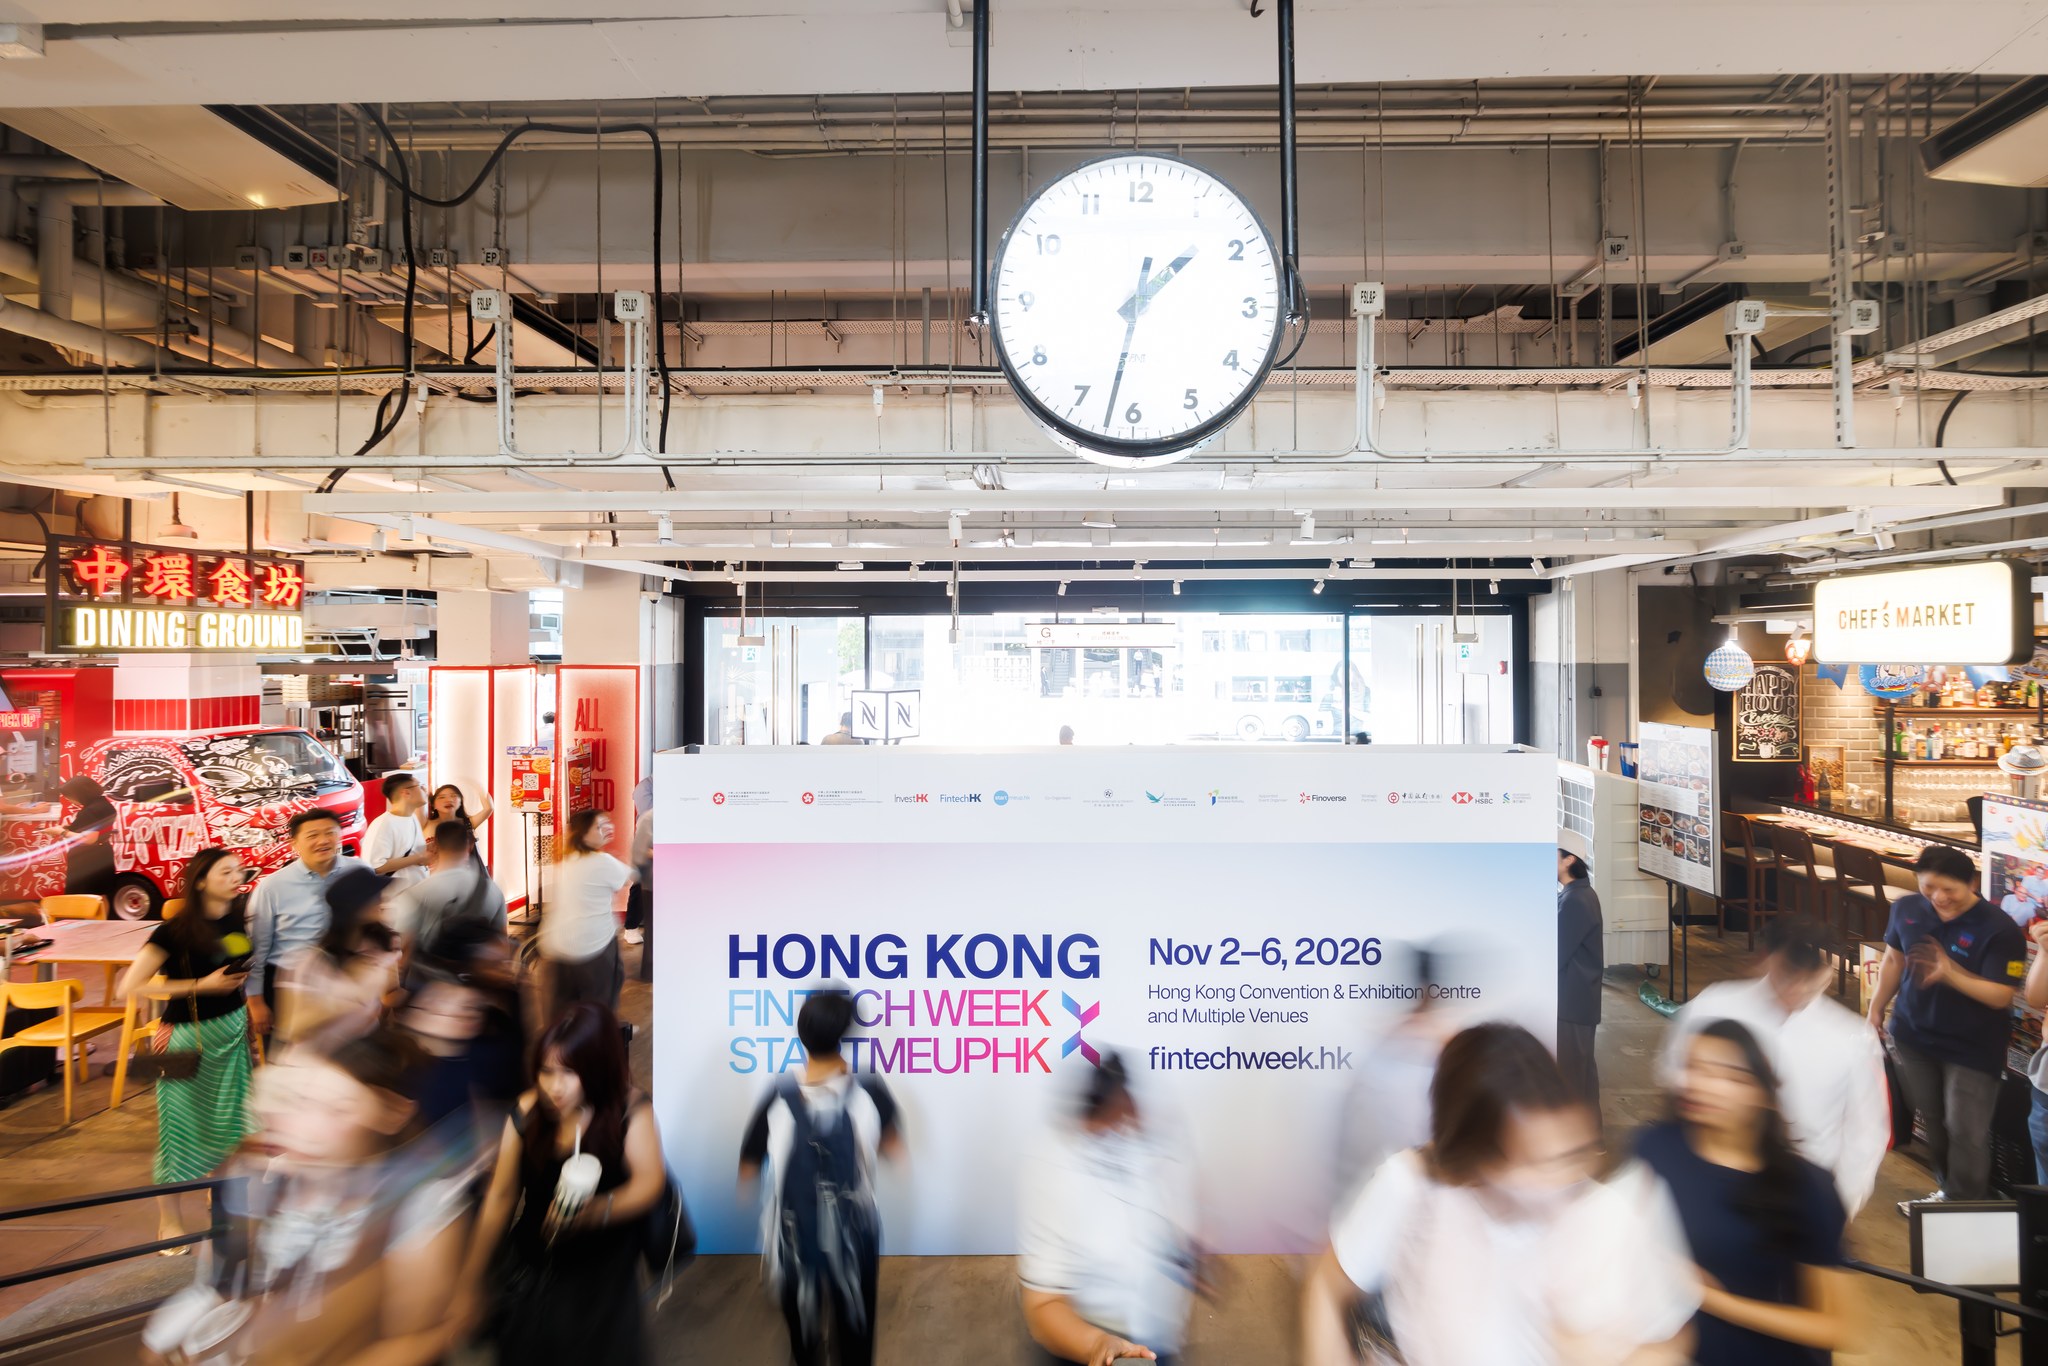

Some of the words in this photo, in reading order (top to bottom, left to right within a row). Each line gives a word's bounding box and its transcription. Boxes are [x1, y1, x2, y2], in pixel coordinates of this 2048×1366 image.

[1129, 181, 1153, 202] 12
[1082, 194, 1100, 215] 11
[1036, 234, 1062, 255] 10
[1228, 239, 1244, 261] 2
[1610, 244, 1622, 255] NP
[485, 252, 497, 263] EP
[1018, 291, 1034, 312] 9
[1241, 297, 1258, 318] 3
[1032, 344, 1047, 366] 8
[1222, 350, 1239, 371] 4
[1074, 385, 1091, 406] 7
[1183, 389, 1198, 410] 5
[1125, 402, 1142, 424] 6
[72, 546, 303, 606] 中環食坊
[1896, 602, 1975, 628] MARKET
[75, 607, 187, 648] DINING
[199, 612, 303, 648] GROUND
[1041, 627, 1051, 638] G
[574, 698, 604, 732] ALL
[1740, 695, 1798, 719] HOUR
[20, 713, 36, 728] UP
[219, 756, 237, 766] PAN
[894, 793, 929, 803] InvestHK
[940, 793, 982, 803] FintechHK
[1311, 795, 1347, 803] Finoverse
[728, 933, 908, 979] HONG
[926, 933, 1100, 979] KONG
[1149, 937, 1213, 966] Nov
[1294, 937, 1382, 966] 2026
[1148, 984, 1191, 1002] Hong
[1195, 984, 1236, 1002] Kong
[1239, 983, 1330, 1000] Convention
[1333, 984, 1345, 1000] &
[1349, 983, 1424, 1000] Exhibition
[1427, 983, 1481, 999] Centre
[728, 989, 915, 1028] FINCH
[922, 989, 1052, 1027] WEEK
[1147, 1008, 1178, 1023] and
[1182, 1008, 1246, 1026] Multiple
[1248, 1008, 1309, 1024] Venues
[728, 1036, 1053, 1075] STATMEUPHK
[1148, 1045, 1353, 1070] fintechweek.hk
